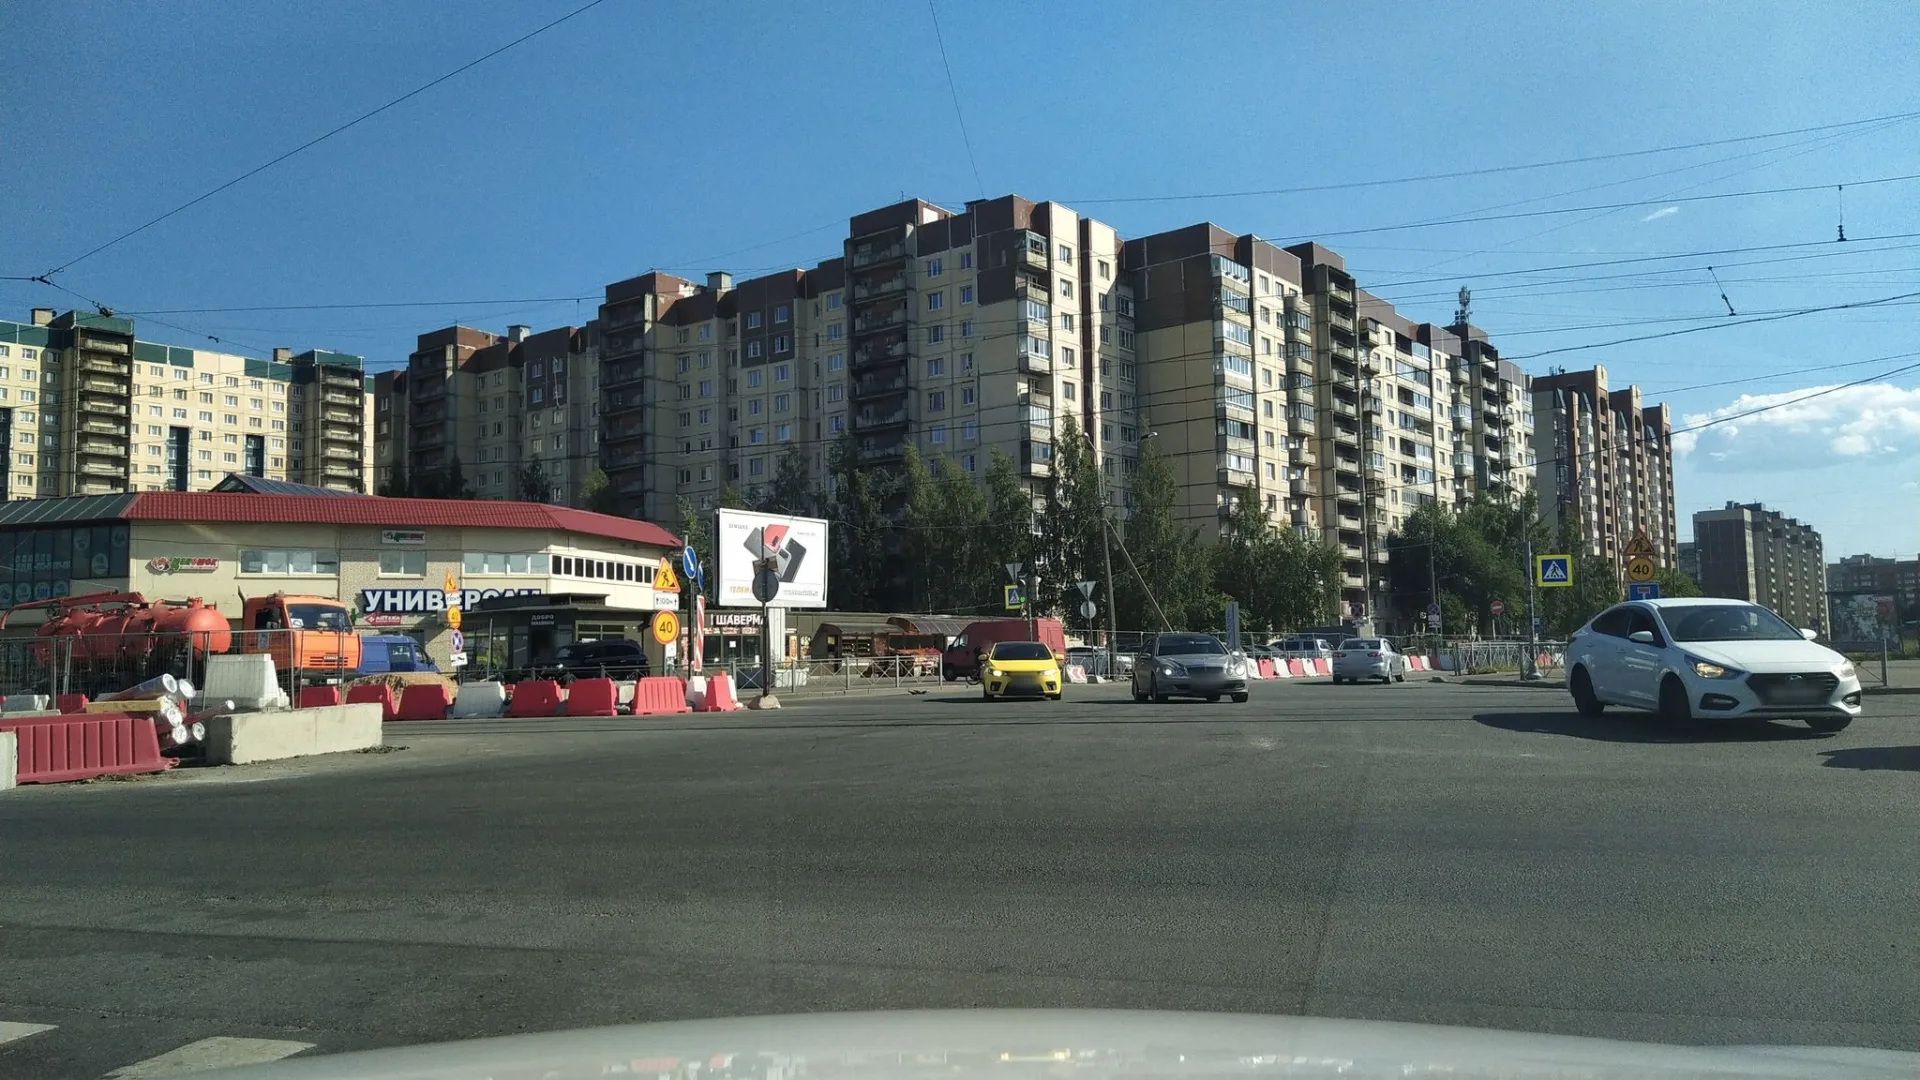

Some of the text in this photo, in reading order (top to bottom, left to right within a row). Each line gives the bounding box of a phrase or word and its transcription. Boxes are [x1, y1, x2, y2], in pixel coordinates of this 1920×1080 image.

[1632, 565, 1649, 575] 40
[364, 590, 542, 613] УНИВЕР
[659, 622, 673, 634] 40
